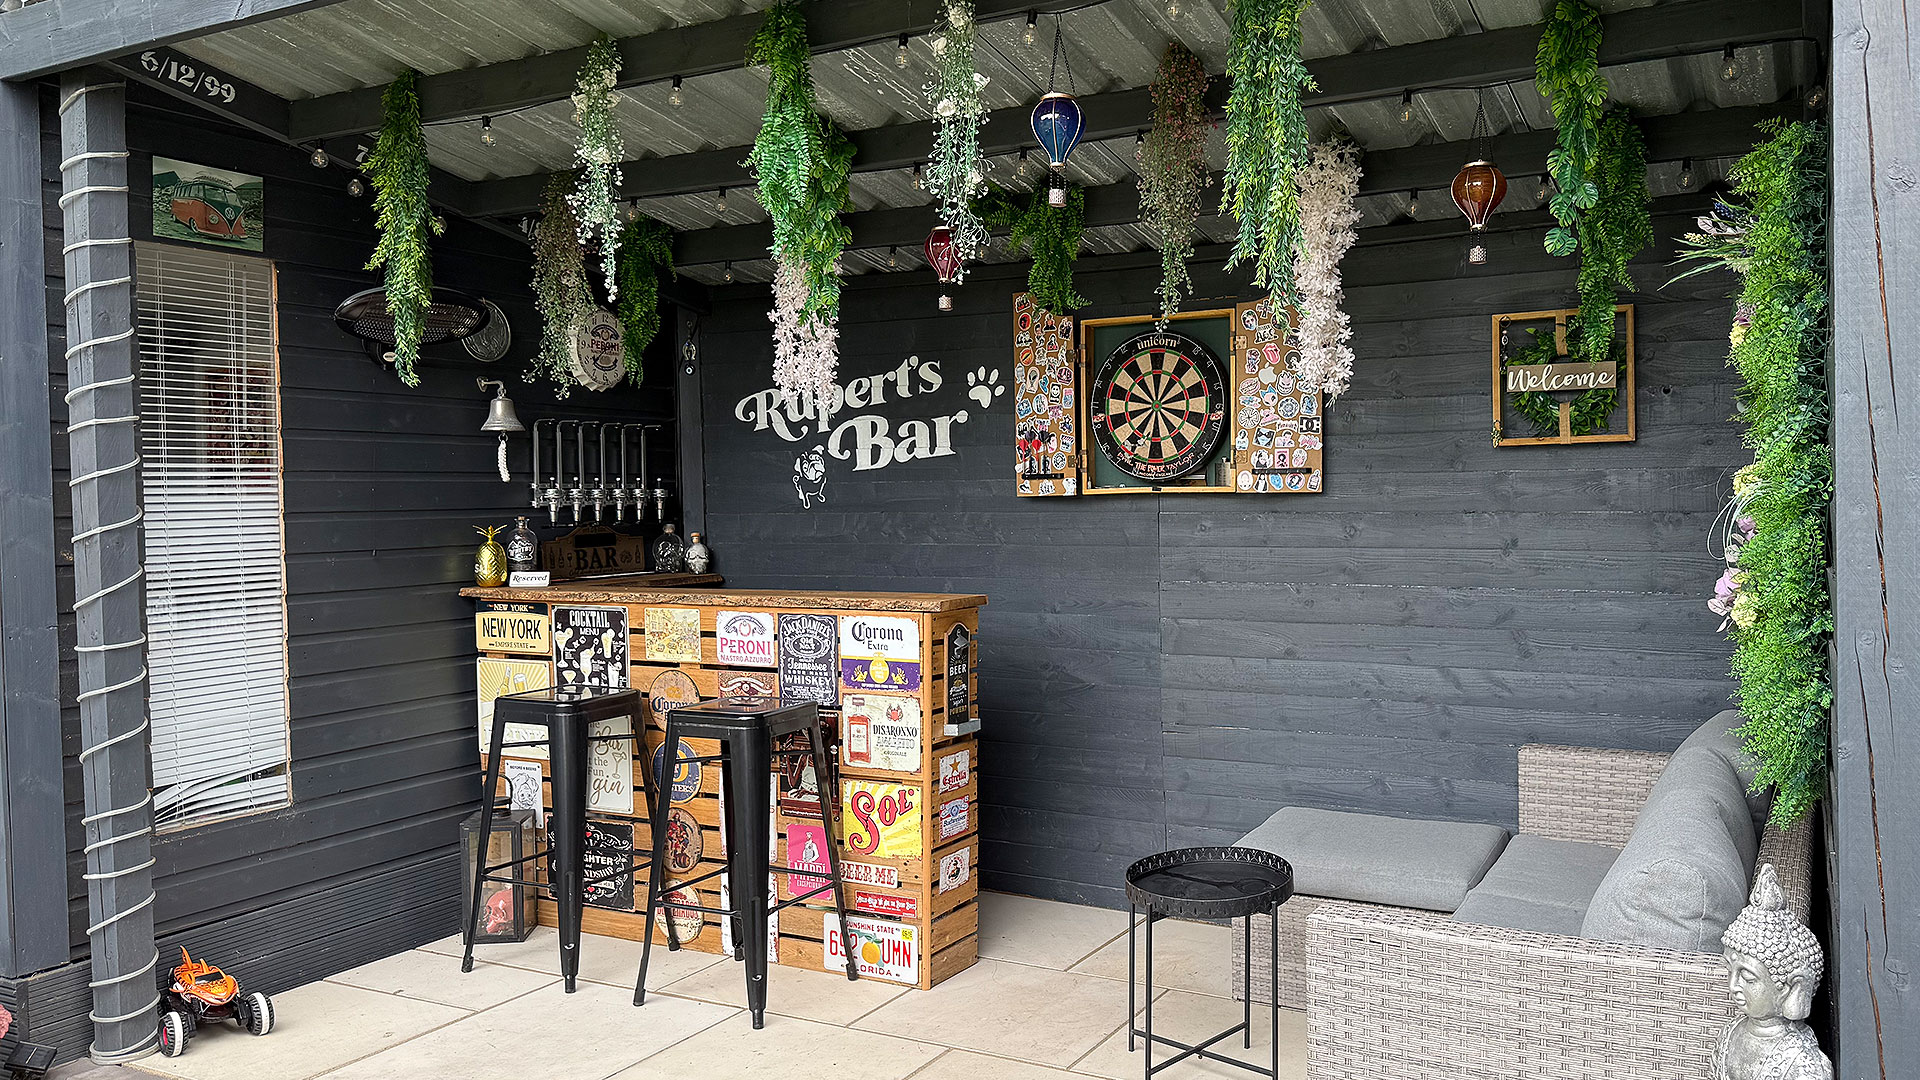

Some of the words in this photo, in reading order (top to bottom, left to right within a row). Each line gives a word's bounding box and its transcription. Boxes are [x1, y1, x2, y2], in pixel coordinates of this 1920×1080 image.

[141, 51, 236, 103] 6/12/99
[1136, 335, 1177, 350] unicorn
[1508, 364, 1615, 392] Welcome
[734, 355, 943, 442] Rupert's
[827, 410, 968, 472] Bar
[574, 547, 619, 571] BAR
[512, 574, 548, 583] Reserved
[493, 603, 508, 611] NEW
[510, 604, 529, 612] YORK
[569, 610, 610, 628] COCKTAIL
[482, 617, 506, 638] NEW
[506, 618, 541, 640] YORK
[579, 627, 600, 636] MENU
[851, 621, 903, 642] Corona
[720, 637, 771, 656] PERONI
[867, 640, 889, 651] Extra
[949, 663, 967, 677] BEER
[784, 674, 832, 687] WHISKEY
[873, 724, 918, 738] DISARONNO
[594, 756, 609, 767] the
[587, 766, 604, 776] Fun
[591, 775, 625, 805] gin
[583, 854, 614, 867] GHTER
[840, 862, 873, 882] BEER
[874, 868, 897, 886] ME
[846, 920, 875, 932] SUNSHINE
[876, 925, 895, 935] STATE
[881, 937, 912, 969] UMN
[856, 964, 893, 977] ORIDA
